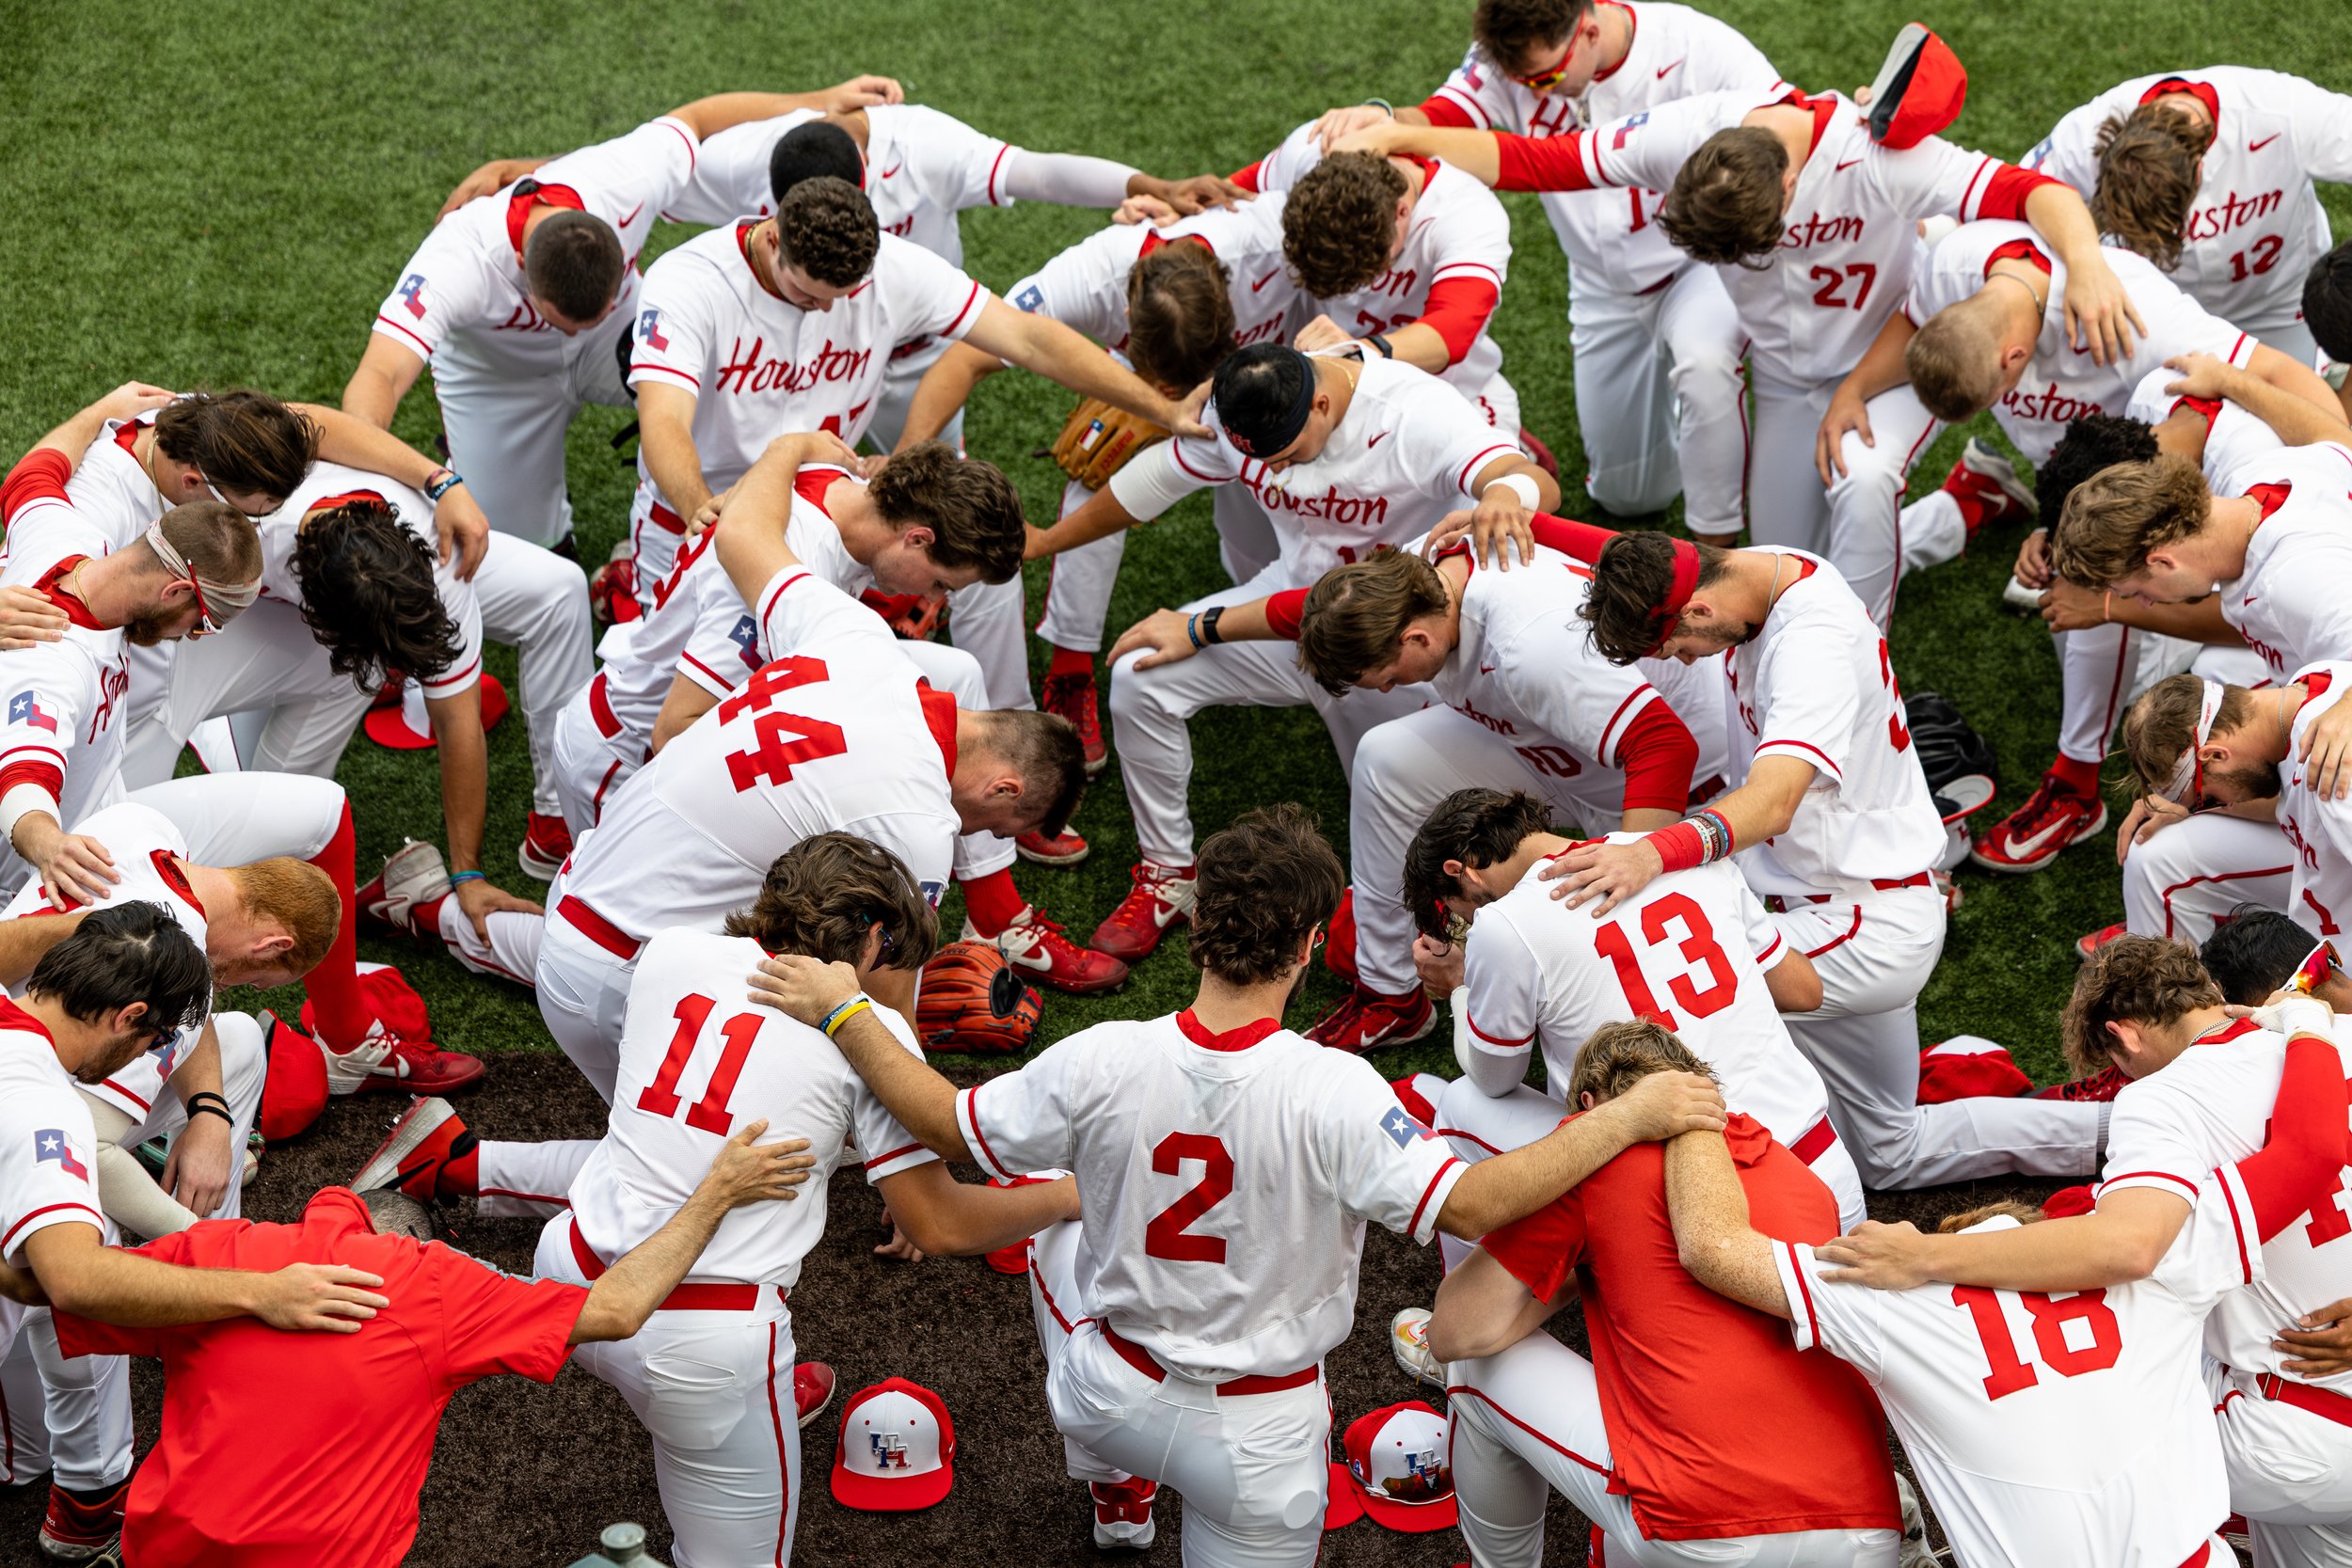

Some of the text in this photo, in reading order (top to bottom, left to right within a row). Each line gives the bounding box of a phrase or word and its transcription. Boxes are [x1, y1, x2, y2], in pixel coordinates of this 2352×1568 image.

[1776, 212, 1865, 249] ston
[2229, 234, 2283, 283] 12
[1809, 263, 1877, 311] 27
[715, 335, 872, 396] Houston
[2002, 381, 2103, 422] uston
[1239, 455, 1389, 527] Houston
[718, 655, 849, 794] 44
[1594, 891, 1739, 1034] 13
[636, 992, 767, 1138] 11
[1145, 1131, 1235, 1265] 2
[1951, 1283, 2123, 1402] 18
